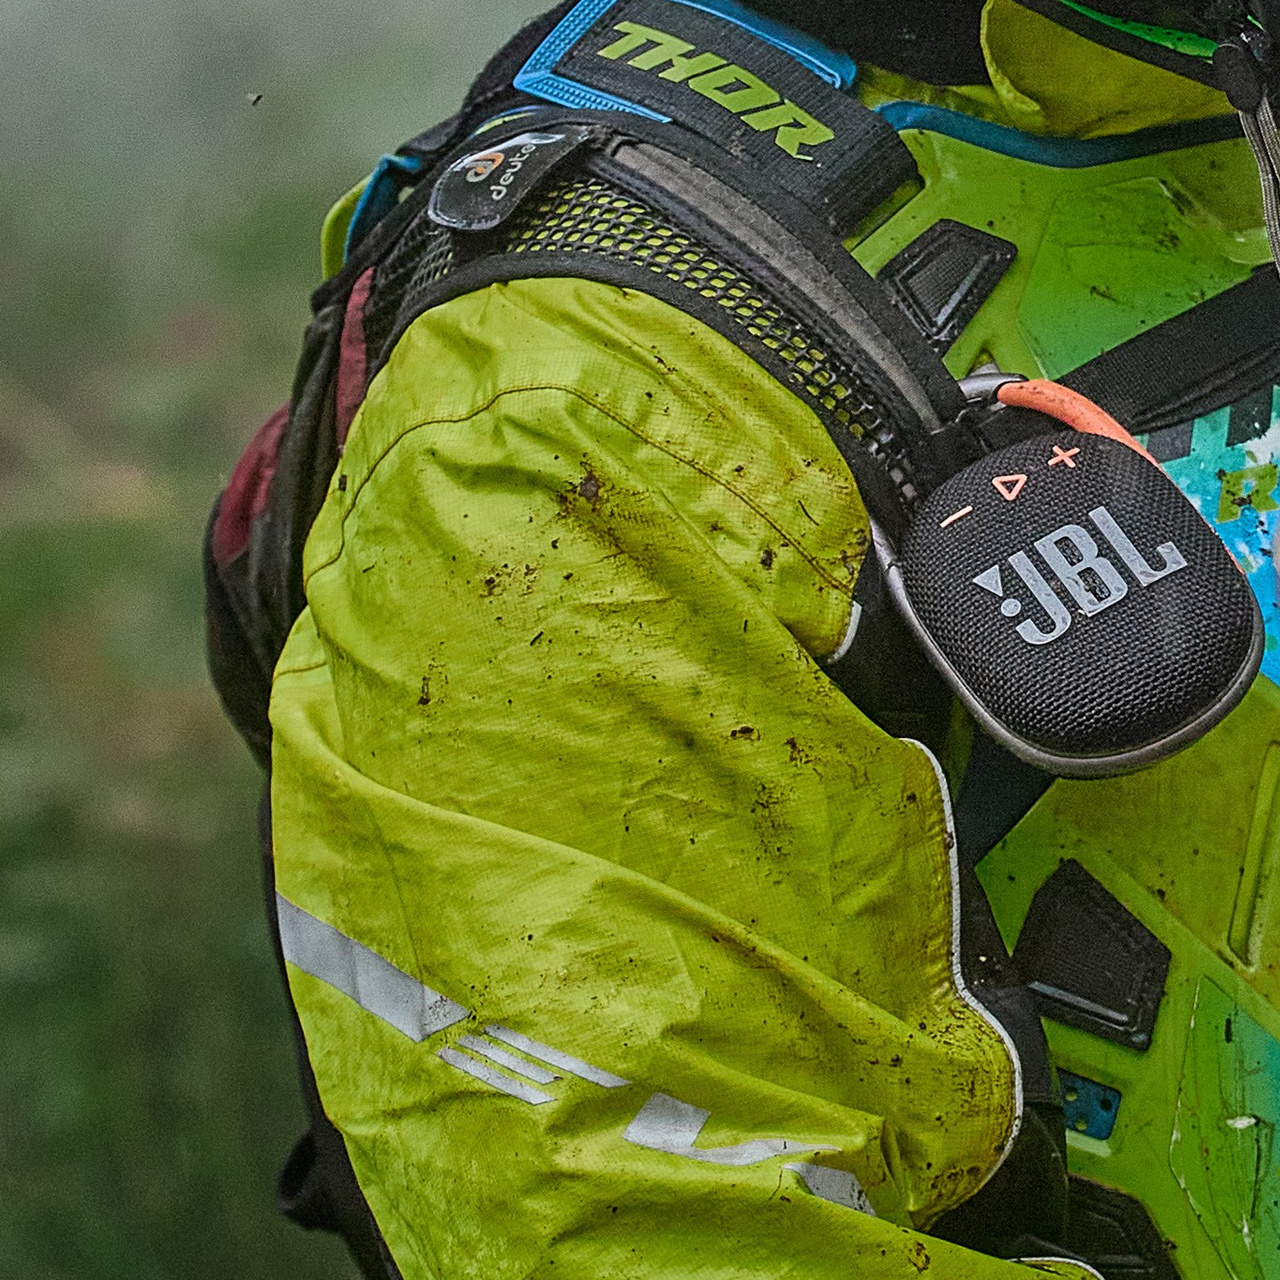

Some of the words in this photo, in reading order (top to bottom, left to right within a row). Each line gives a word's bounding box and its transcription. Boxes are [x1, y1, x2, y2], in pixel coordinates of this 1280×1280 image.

[597, 20, 835, 162] THOR
[490, 143, 537, 200] deute
[1007, 505, 1188, 645] JBL
